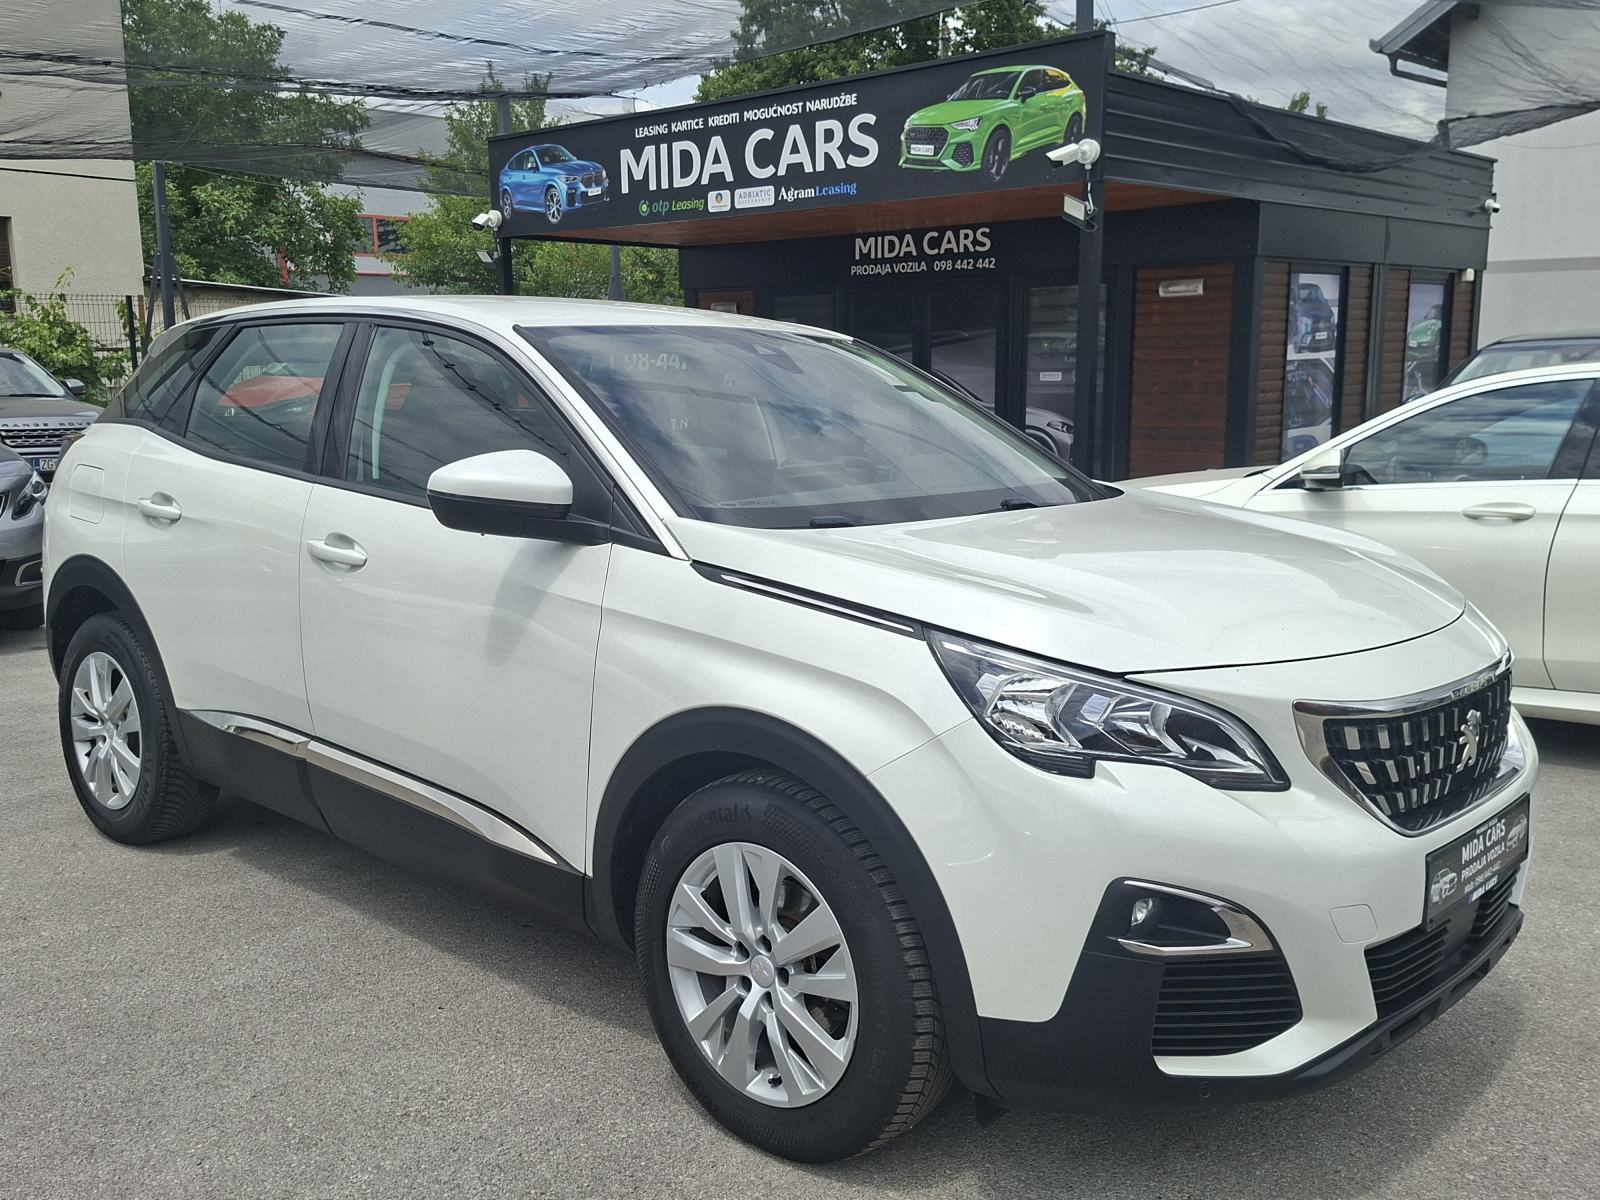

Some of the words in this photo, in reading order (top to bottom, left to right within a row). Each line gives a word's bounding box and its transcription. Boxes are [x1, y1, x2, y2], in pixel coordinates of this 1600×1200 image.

[635, 123, 668, 138] LEASING
[671, 118, 704, 133] KARTICE
[708, 112, 740, 128] KREDITI
[743, 102, 803, 122] MOGUĆNOST
[806, 93, 858, 113] NARUDŽBE
[620, 135, 734, 194] MIDA
[744, 113, 879, 179] CARS
[652, 200, 669, 215] otp
[671, 197, 705, 211] Leasing
[738, 189, 771, 200] ADRIATIC
[854, 233, 917, 261] MIDA
[923, 227, 992, 255] CARS
[851, 263, 892, 276] PRODAJA
[893, 261, 927, 273] VOZILA
[933, 260, 953, 271] 098
[954, 259, 974, 270] 442
[976, 257, 996, 269] 442
[1461, 834, 1484, 864] MIDA
[1485, 819, 1506, 847] CARS
[1461, 855, 1487, 882] PRODAJA
[1487, 842, 1505, 863] VOZILA
